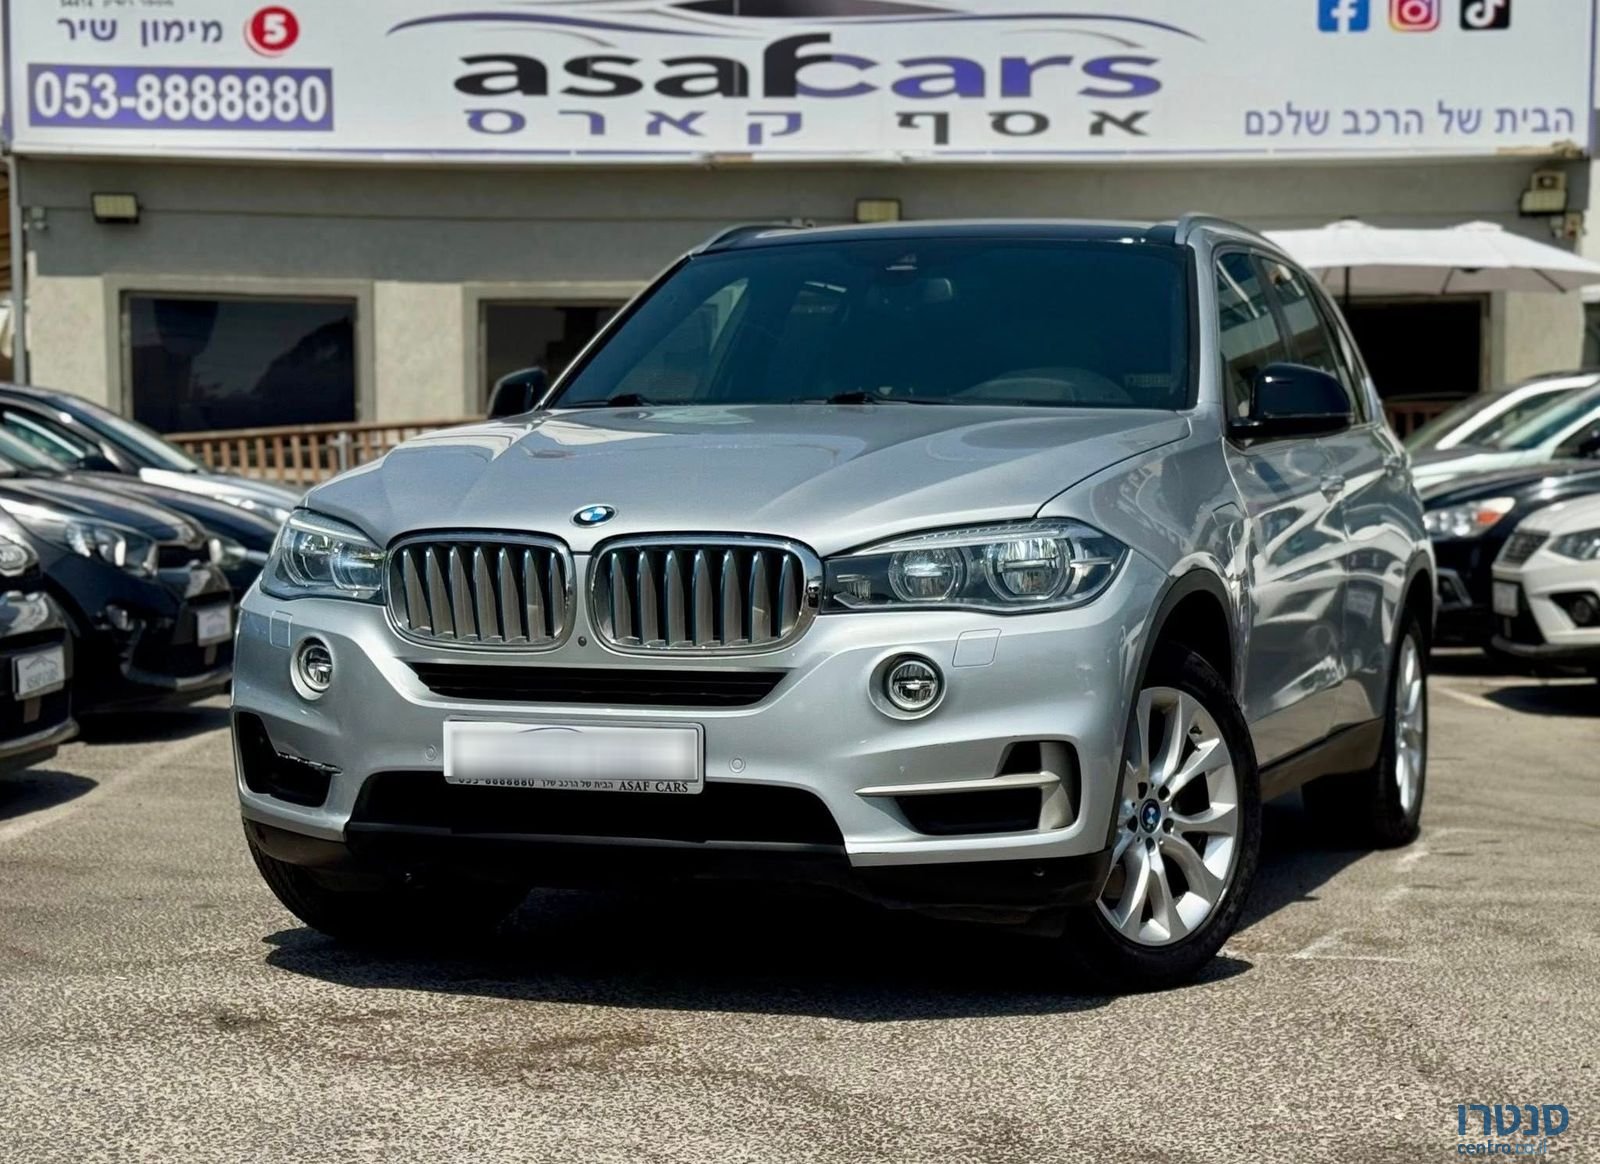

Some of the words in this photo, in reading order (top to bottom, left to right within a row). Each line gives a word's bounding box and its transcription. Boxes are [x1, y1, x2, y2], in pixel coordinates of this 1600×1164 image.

[58, 19, 117, 41] שיר
[141, 19, 223, 47] מימון
[34, 71, 327, 122] 053-8888880
[463, 108, 802, 146] קארס
[896, 110, 1151, 146] אסף
[1244, 101, 1330, 137] שלכם
[1342, 108, 1424, 136] הרכב
[1437, 100, 1482, 135] של
[1495, 106, 1575, 134] הבית
[619, 780, 650, 793] ASAF
[655, 781, 689, 793] CARS
